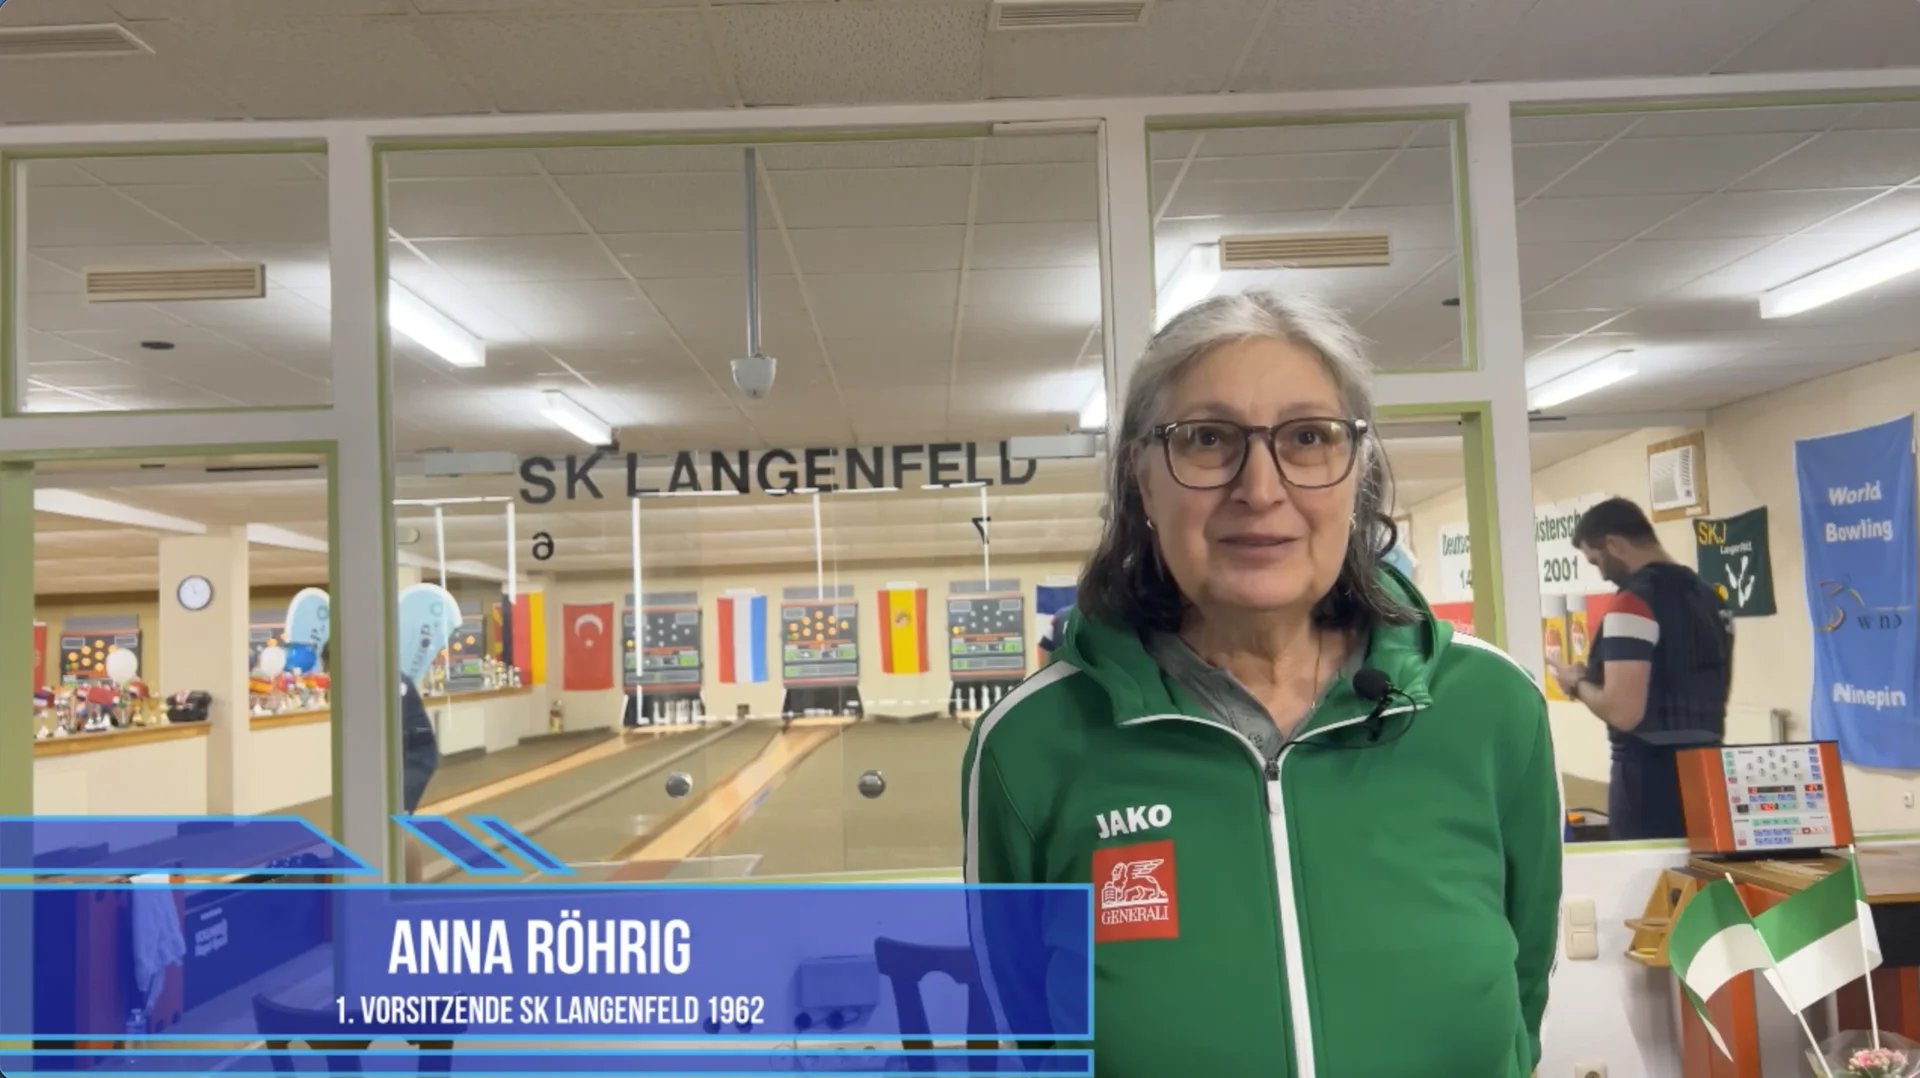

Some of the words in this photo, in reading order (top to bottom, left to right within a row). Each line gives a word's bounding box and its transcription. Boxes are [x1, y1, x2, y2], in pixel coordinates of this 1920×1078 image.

[519, 452, 604, 504] SK
[626, 441, 1037, 499] LANGENFELD
[1828, 480, 1882, 506] World
[1442, 533, 1471, 556] Deutsc
[1534, 508, 1582, 543] istersch
[1698, 521, 1727, 545] SKJ
[1825, 518, 1894, 542] Bowling
[1543, 555, 1579, 583] 2001
[1832, 682, 1907, 711] Ninepin
[1096, 804, 1172, 839] JAKO
[1101, 905, 1169, 925] GENERALI
